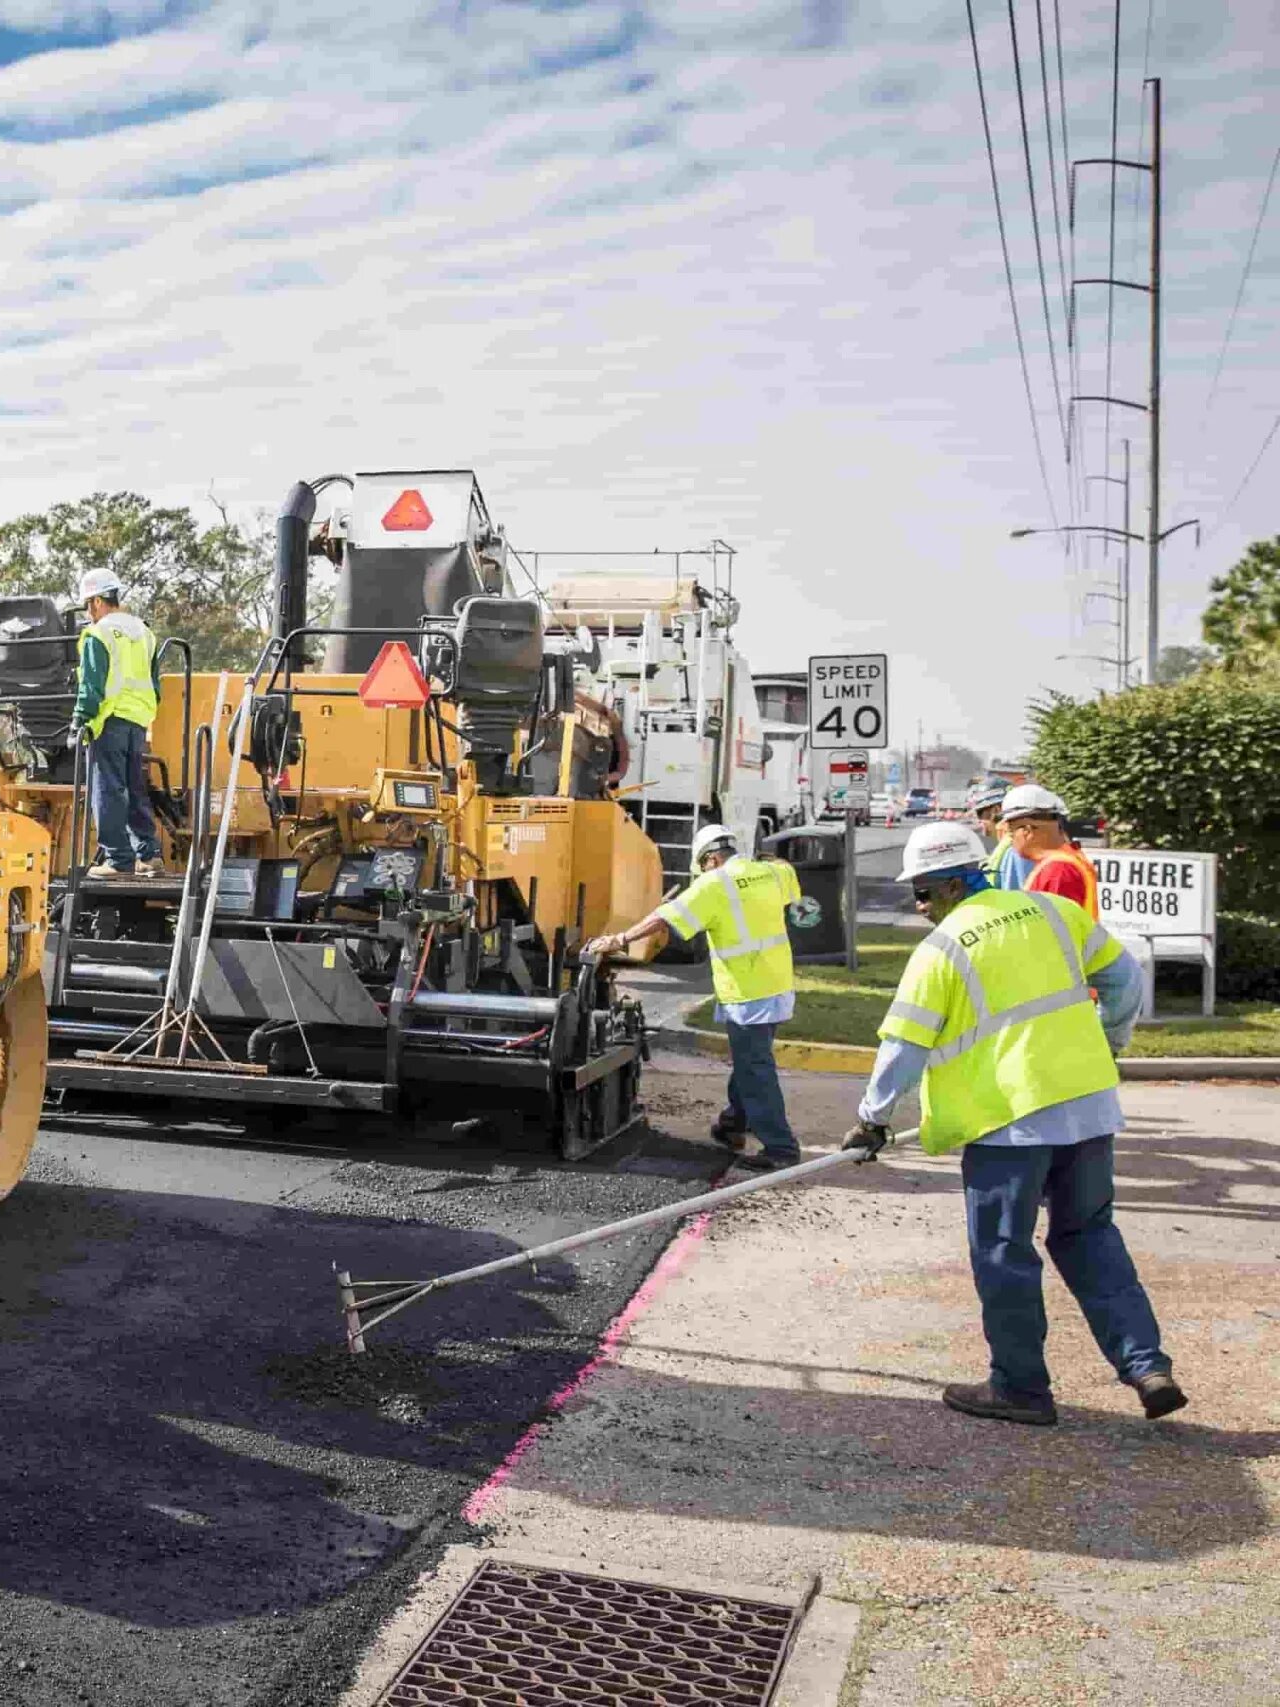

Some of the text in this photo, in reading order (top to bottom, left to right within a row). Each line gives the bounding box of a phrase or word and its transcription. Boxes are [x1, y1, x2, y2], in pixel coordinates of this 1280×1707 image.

[816, 664, 881, 681] SPEED
[823, 684, 874, 700] LIMIT
[816, 705, 882, 739] 40
[1128, 861, 1194, 889] HERE
